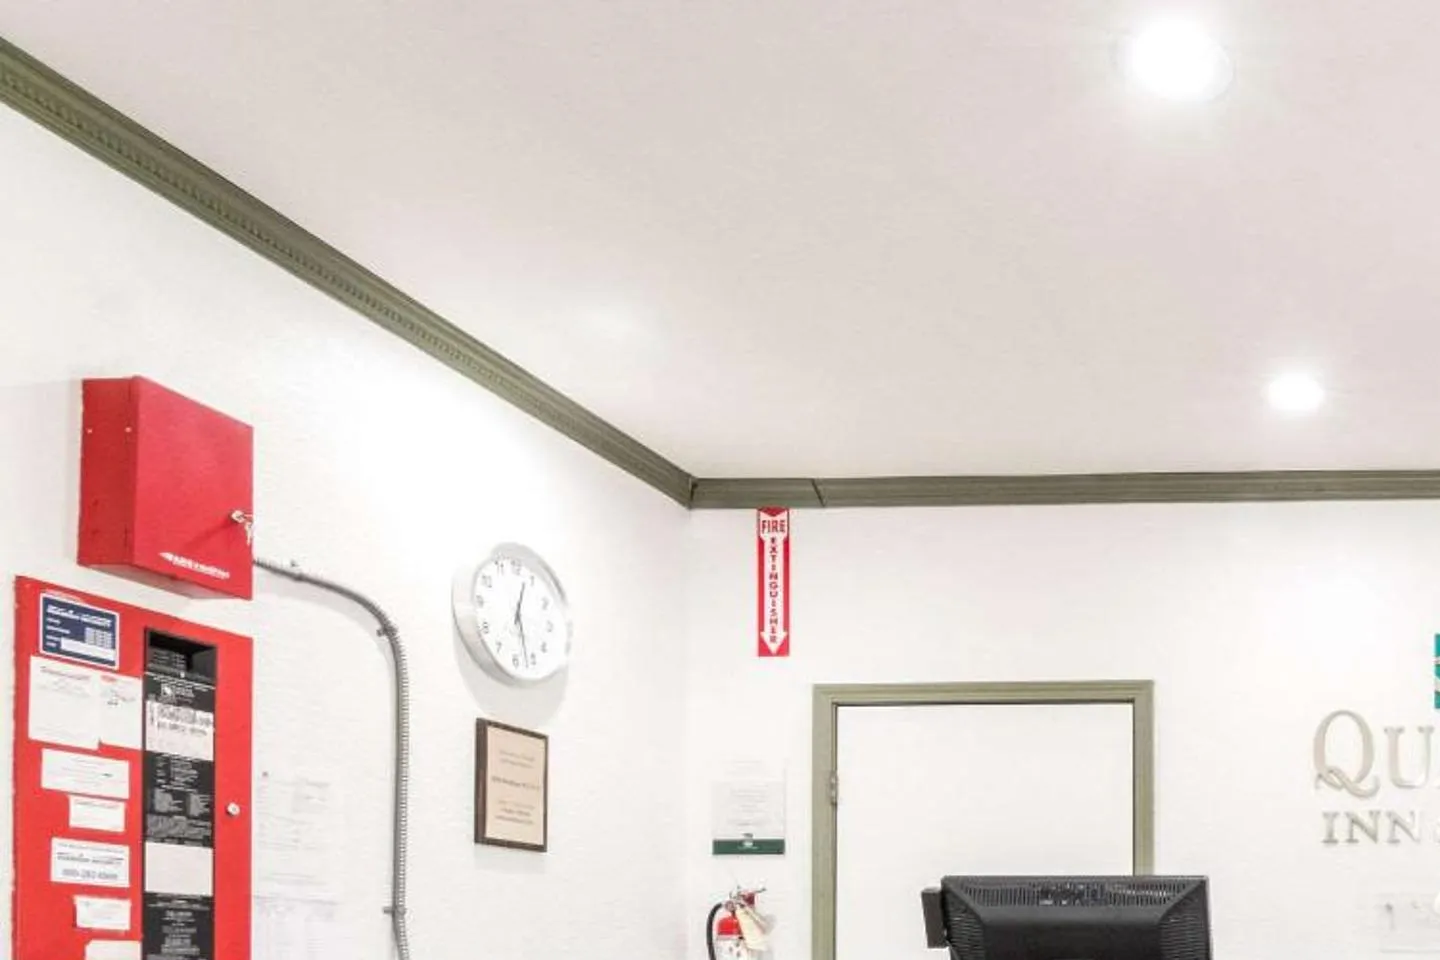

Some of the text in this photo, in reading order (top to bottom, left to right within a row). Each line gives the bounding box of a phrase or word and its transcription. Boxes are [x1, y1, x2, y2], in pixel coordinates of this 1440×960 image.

[761, 519, 786, 533] FIRE
[768, 537, 779, 643] EXTINGUISHER
[1321, 809, 1420, 845] INN
